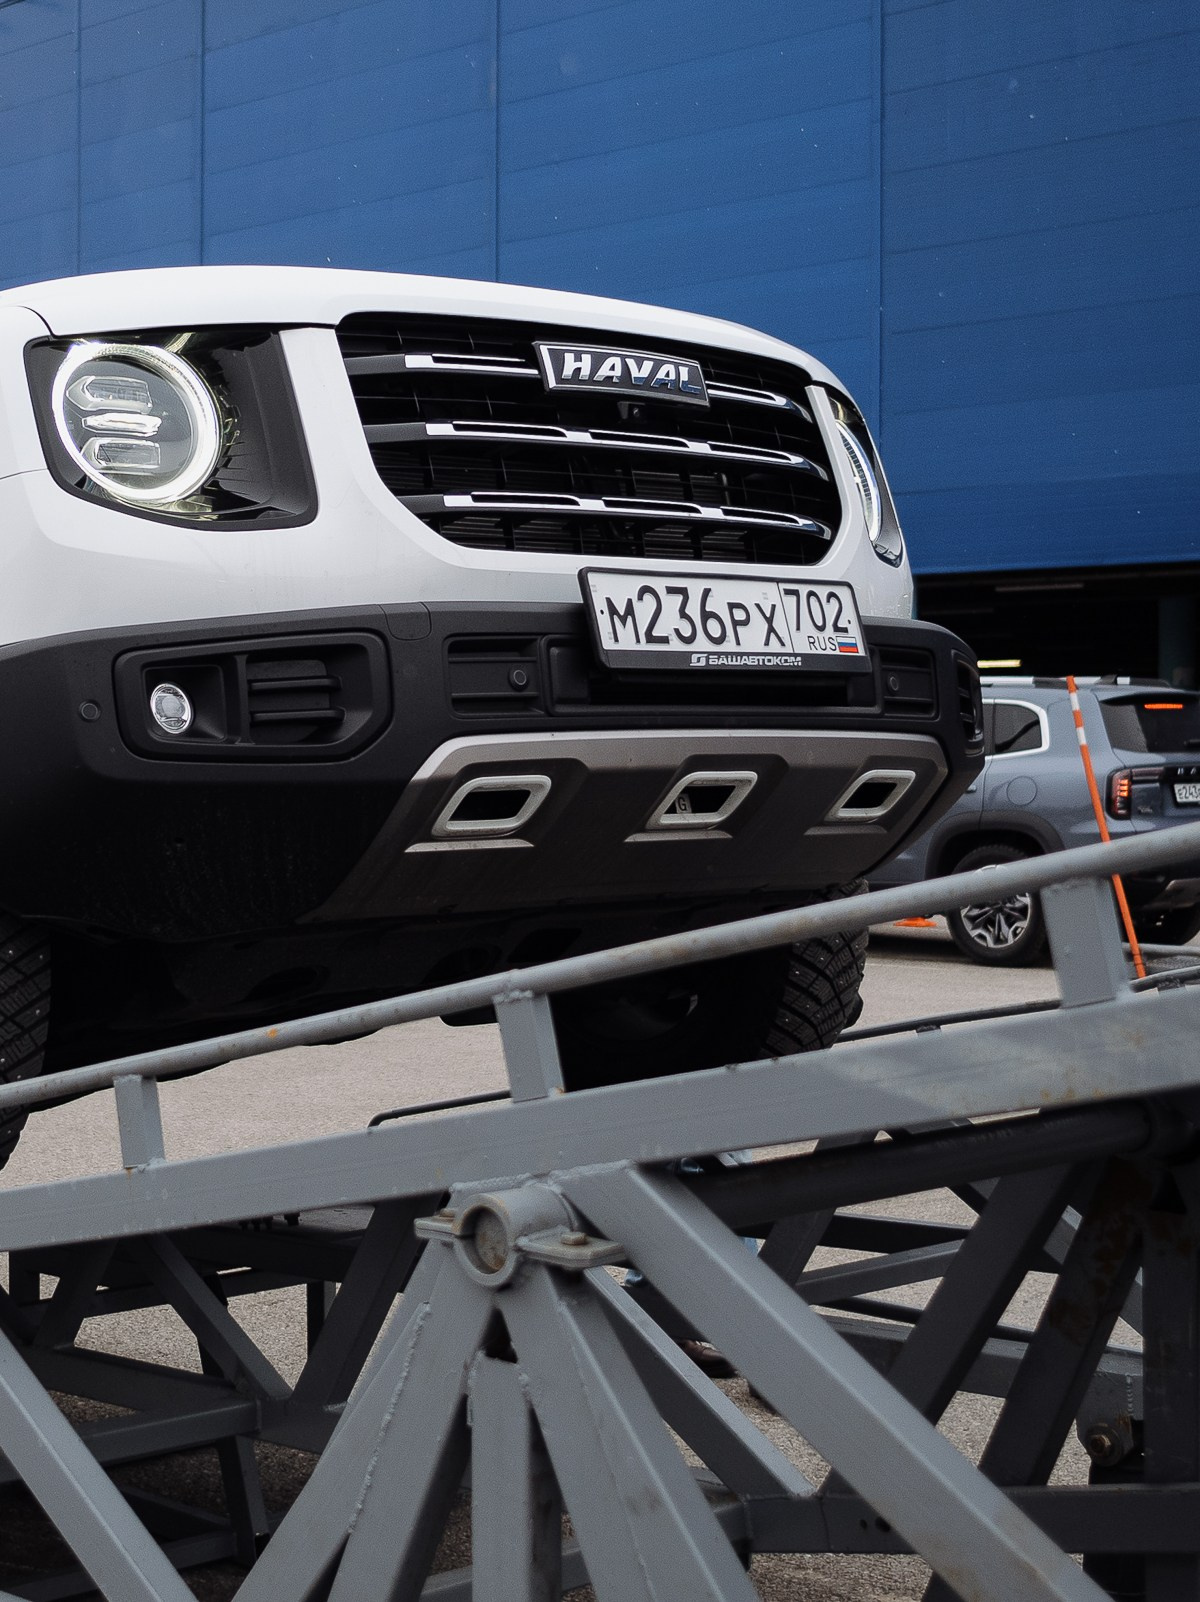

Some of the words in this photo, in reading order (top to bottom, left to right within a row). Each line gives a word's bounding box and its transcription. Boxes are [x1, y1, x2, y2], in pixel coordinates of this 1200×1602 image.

[562, 352, 702, 394] HAVAL
[605, 584, 786, 647] М236РХ
[783, 588, 850, 634] 702
[807, 635, 837, 652] RUS
[708, 655, 802, 667] БАШАВТОКОМ
